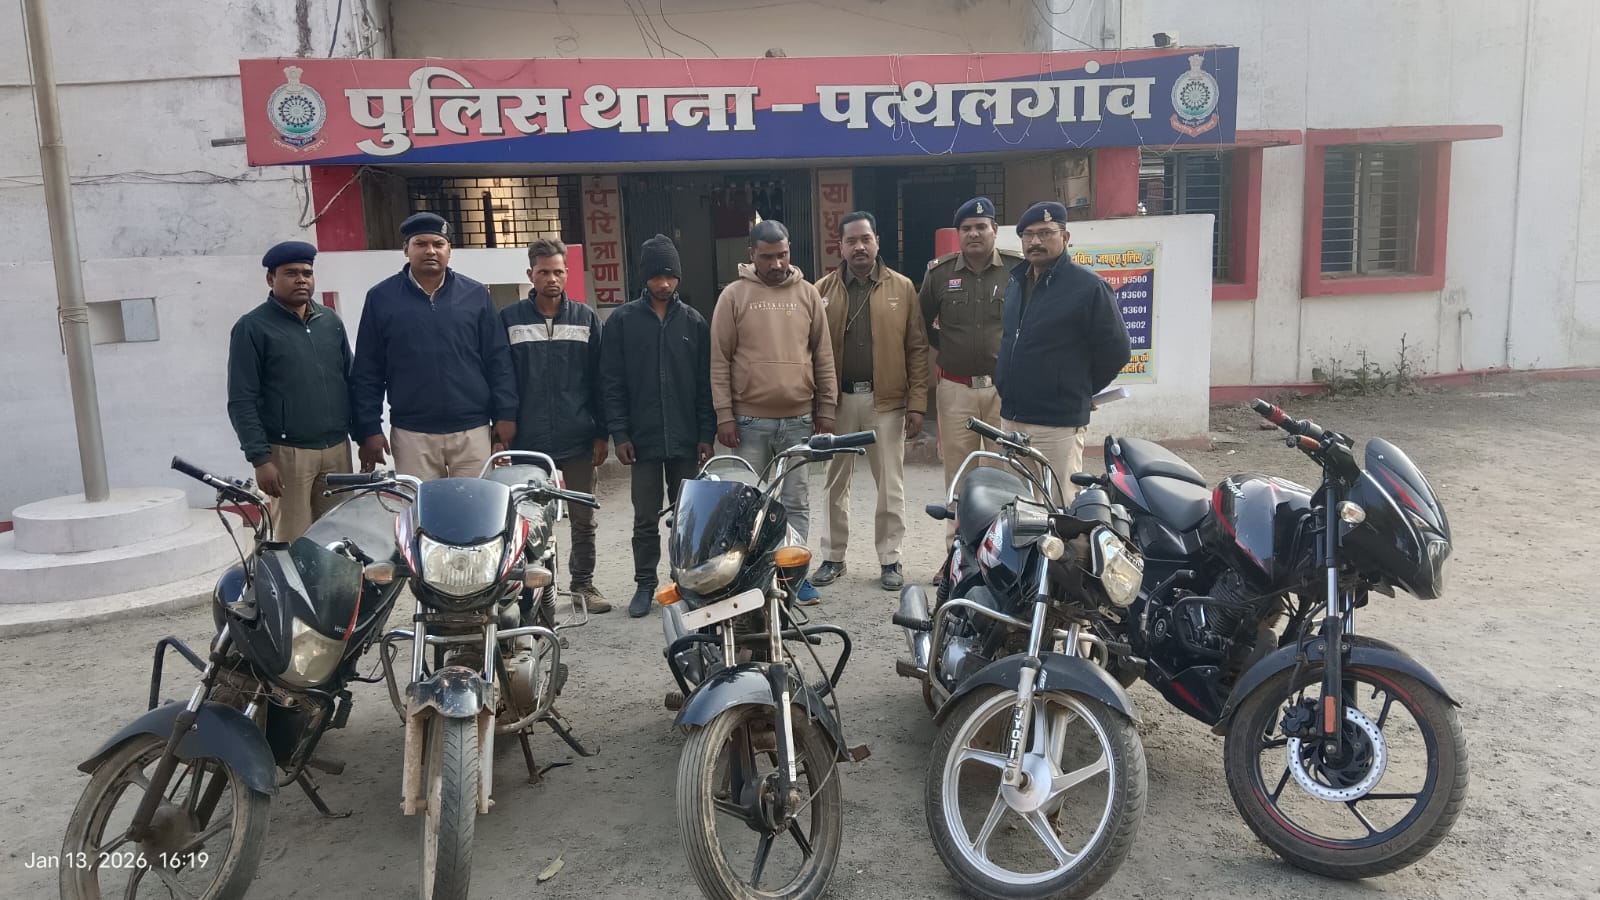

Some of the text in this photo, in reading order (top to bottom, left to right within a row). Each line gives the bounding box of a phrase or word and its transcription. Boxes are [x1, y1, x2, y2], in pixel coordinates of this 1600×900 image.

[344, 66, 571, 156] पुलिस
[580, 84, 760, 133] थाना
[815, 59, 1157, 130] पत्थलगांव
[1122, 275, 1148, 285] 93500
[1121, 290, 1147, 299] 93600
[1122, 305, 1147, 314] 93601
[1126, 320, 1146, 329] 3602
[1009, 710, 1024, 760] JYOTI
